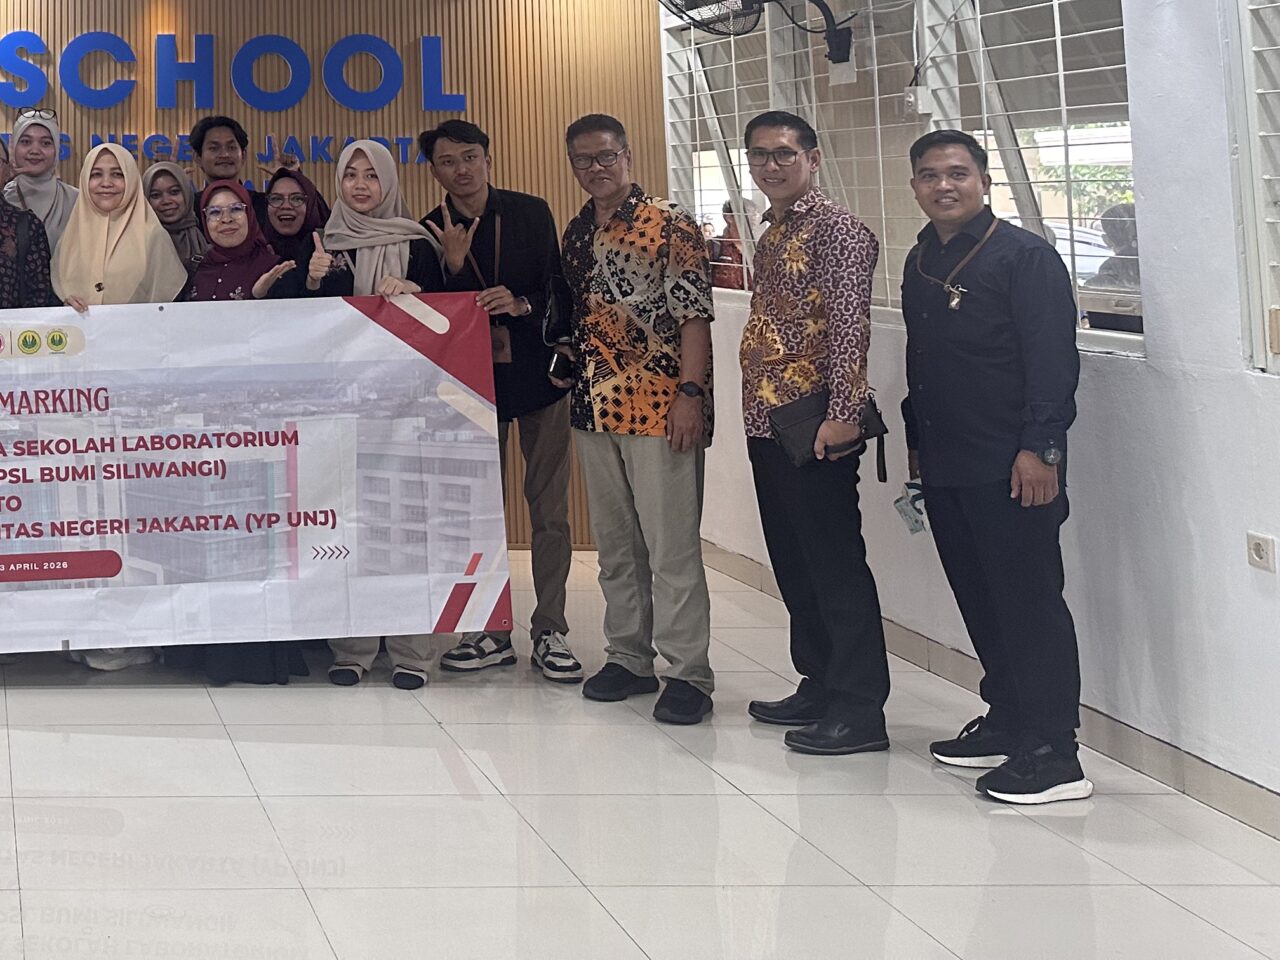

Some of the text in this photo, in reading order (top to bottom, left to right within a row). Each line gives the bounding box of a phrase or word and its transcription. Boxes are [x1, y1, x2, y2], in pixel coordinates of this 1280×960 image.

[12, 437, 115, 457] SEKOLAH
[122, 429, 300, 452] LABORATORIUM
[39, 464, 96, 483] BUMI
[102, 459, 228, 481] SILIWANGI)
[50, 518, 130, 537] NEGERI
[136, 514, 240, 534] JAKARTA
[245, 513, 281, 532] (YP
[287, 509, 338, 530] UNJ)
[9, 563, 40, 571] APRIL
[42, 561, 69, 570] 2026
